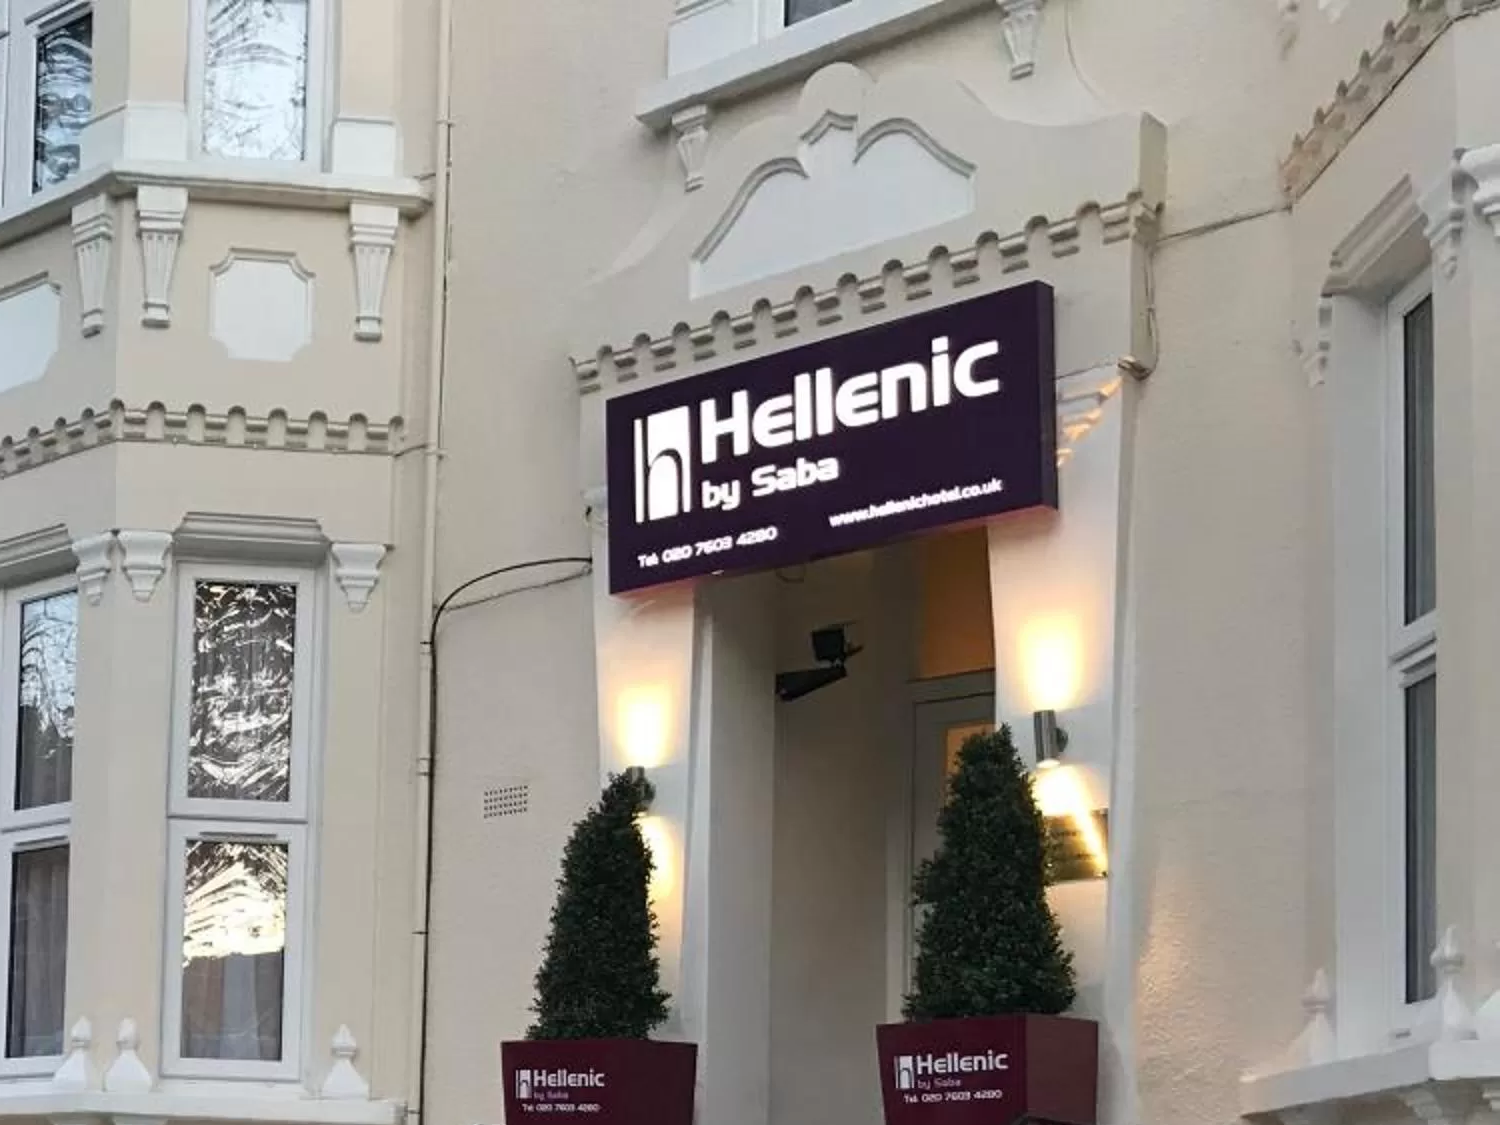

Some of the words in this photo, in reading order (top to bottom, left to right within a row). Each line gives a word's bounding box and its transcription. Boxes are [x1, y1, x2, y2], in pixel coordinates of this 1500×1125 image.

[700, 335, 1000, 464] Hellenic
[702, 480, 741, 512] by
[751, 456, 840, 498] Saba
[662, 545, 693, 563] 020
[694, 535, 734, 557] 7603
[916, 1049, 1009, 1075] Hellenic
[533, 1067, 605, 1087] Hellenic
[917, 1079, 931, 1090] by
[933, 1077, 962, 1088] Saba
[921, 1093, 943, 1103] 020
